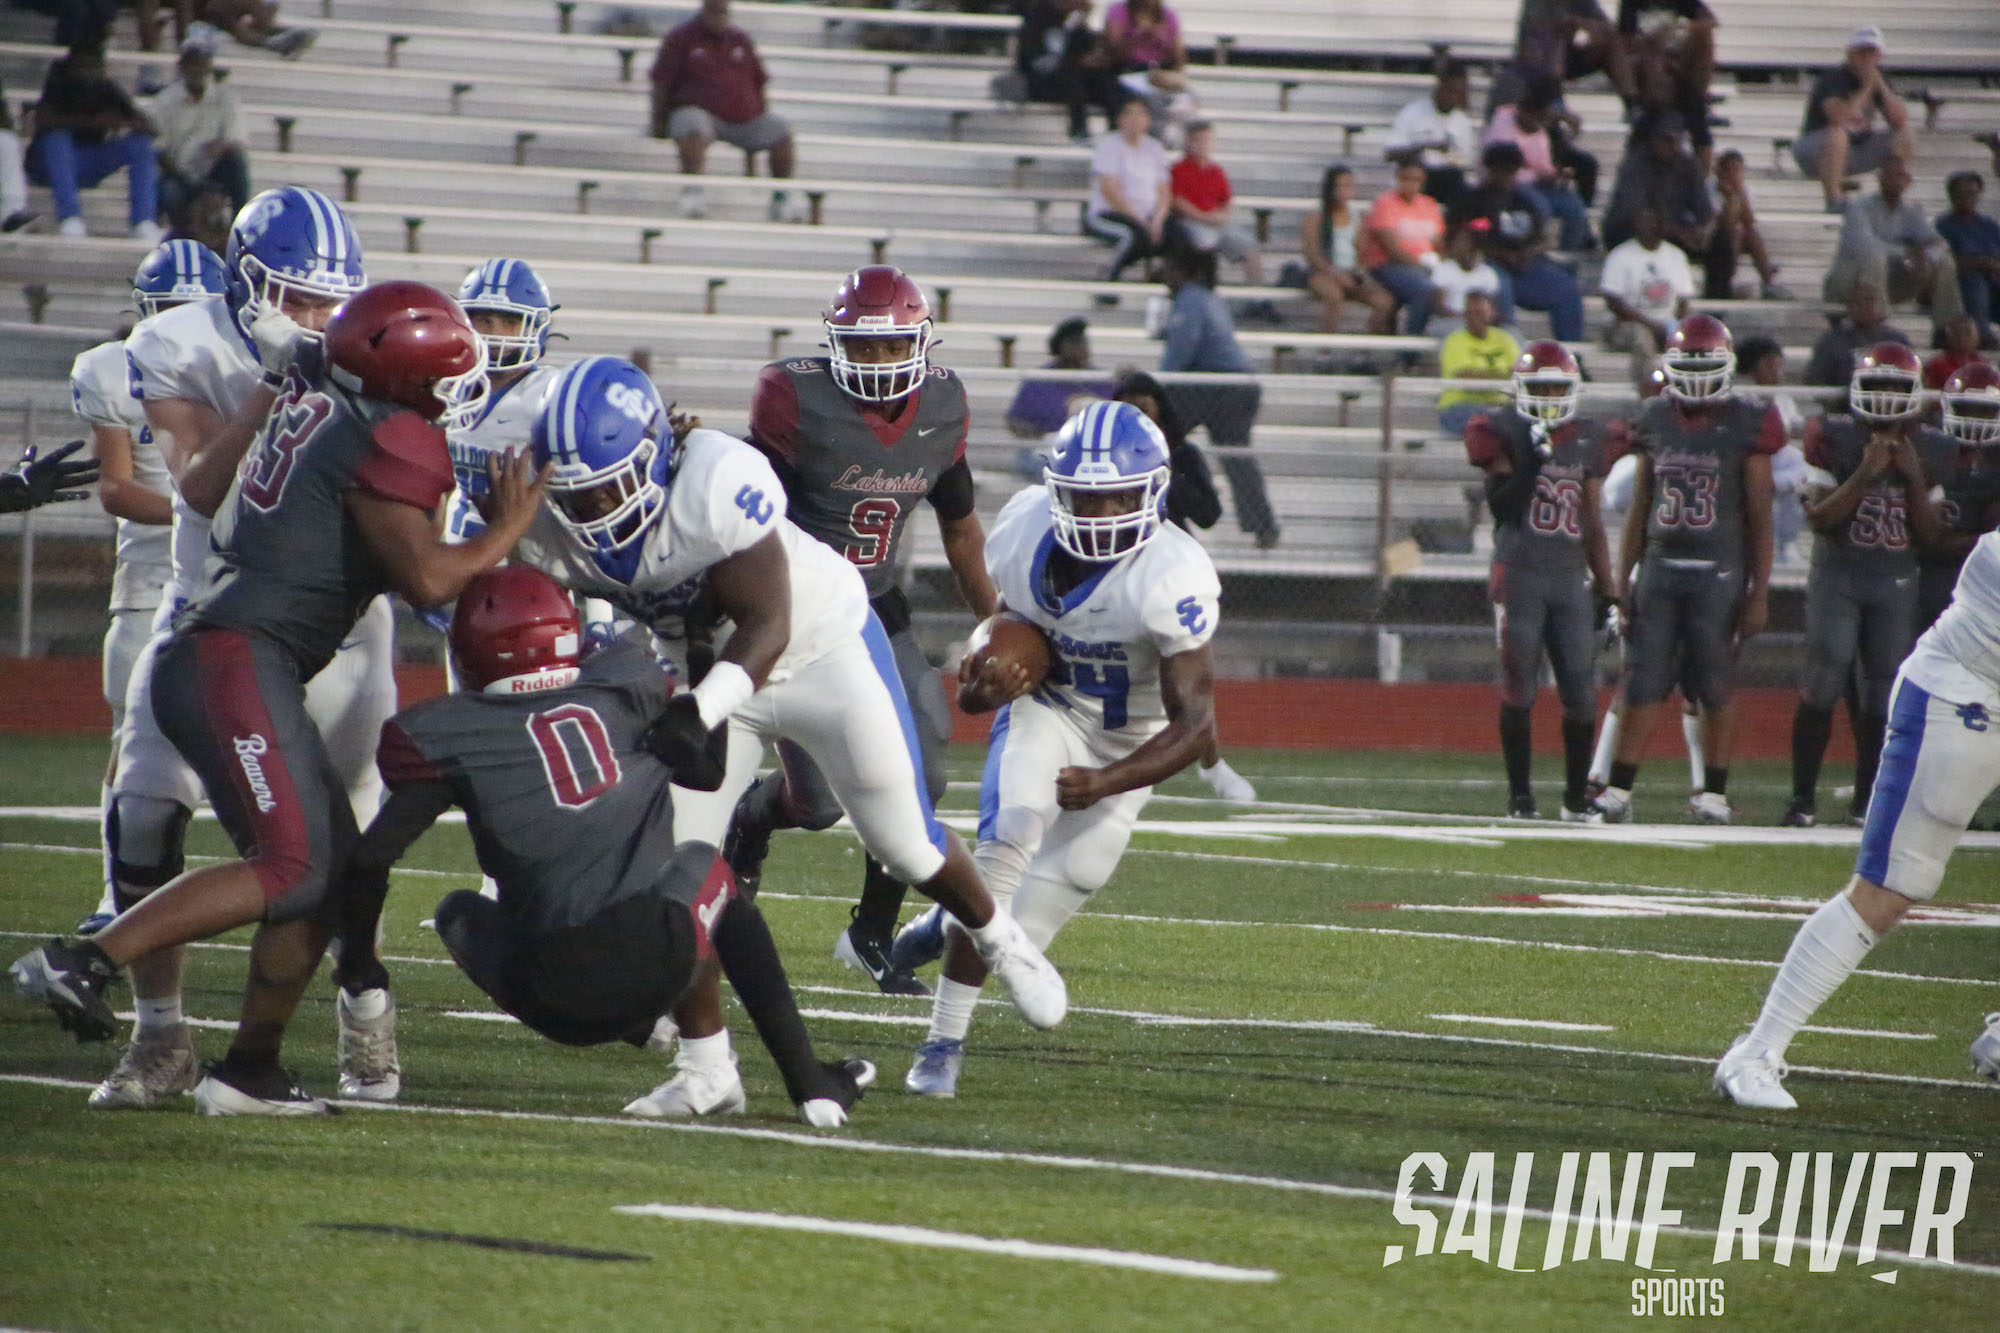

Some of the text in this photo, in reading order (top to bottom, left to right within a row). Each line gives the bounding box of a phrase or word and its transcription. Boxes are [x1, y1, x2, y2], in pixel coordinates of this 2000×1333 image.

[830, 464, 928, 493] Lakeside
[1655, 465, 1720, 528] 53
[734, 483, 774, 526] SC
[844, 497, 901, 568] 9
[1175, 595, 1208, 636] SC
[511, 671, 574, 693] Riddell
